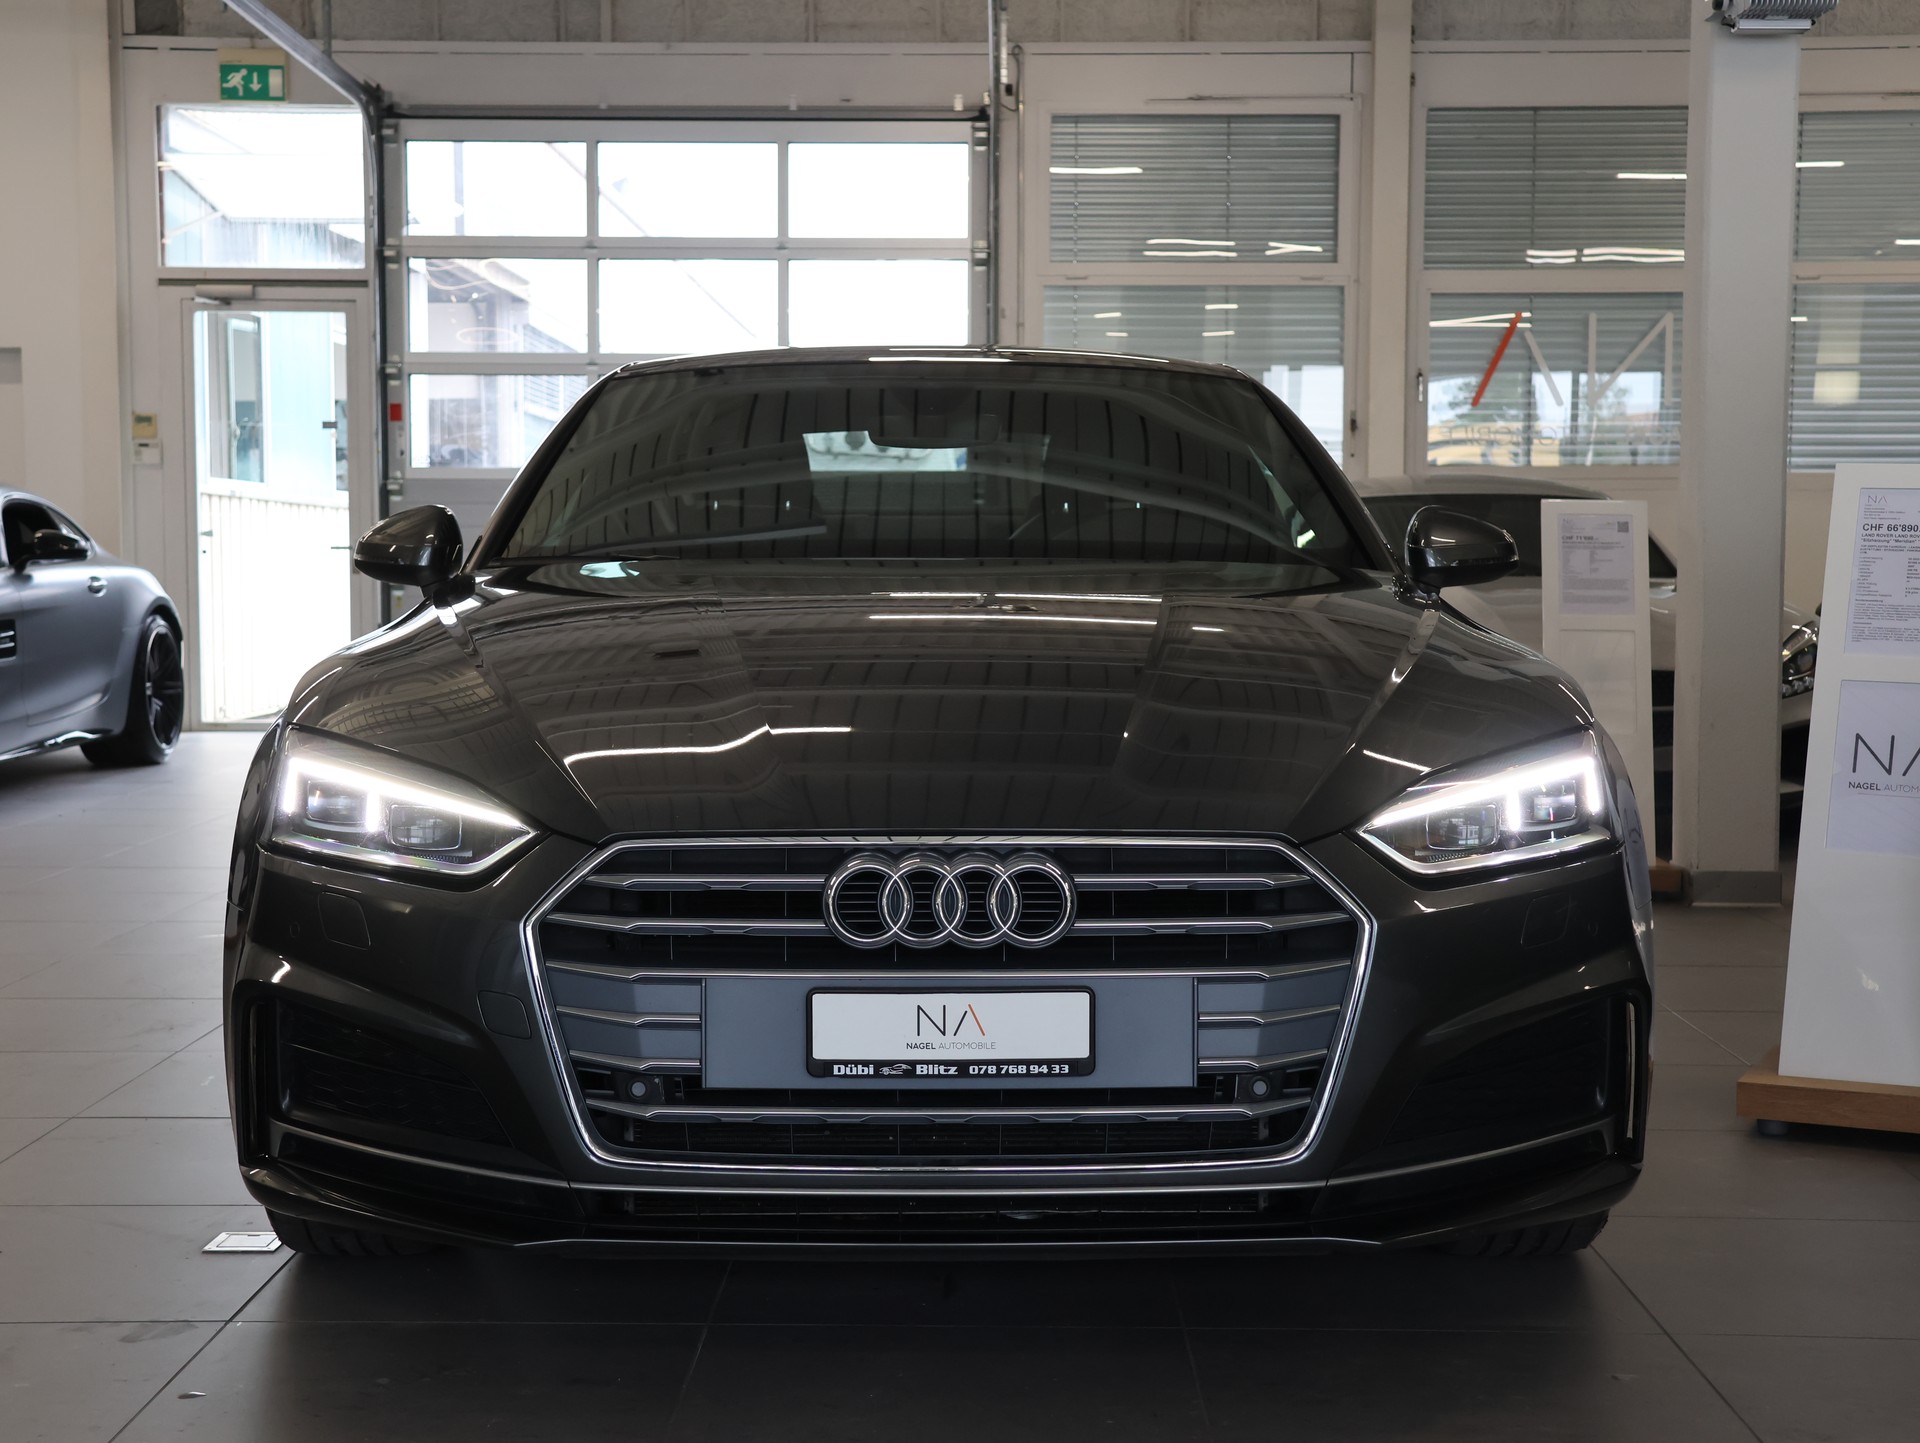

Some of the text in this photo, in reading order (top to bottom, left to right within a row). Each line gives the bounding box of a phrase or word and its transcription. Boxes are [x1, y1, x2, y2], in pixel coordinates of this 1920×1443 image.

[1862, 523, 1884, 532] CHF
[1848, 781, 1920, 793] NAGEL AUTOM
[916, 1003, 986, 1036] NA
[906, 1041, 996, 1050] NAGEL AUTOMOBILE
[833, 1064, 1069, 1075] Dübi Blitz 078 768 94 33
